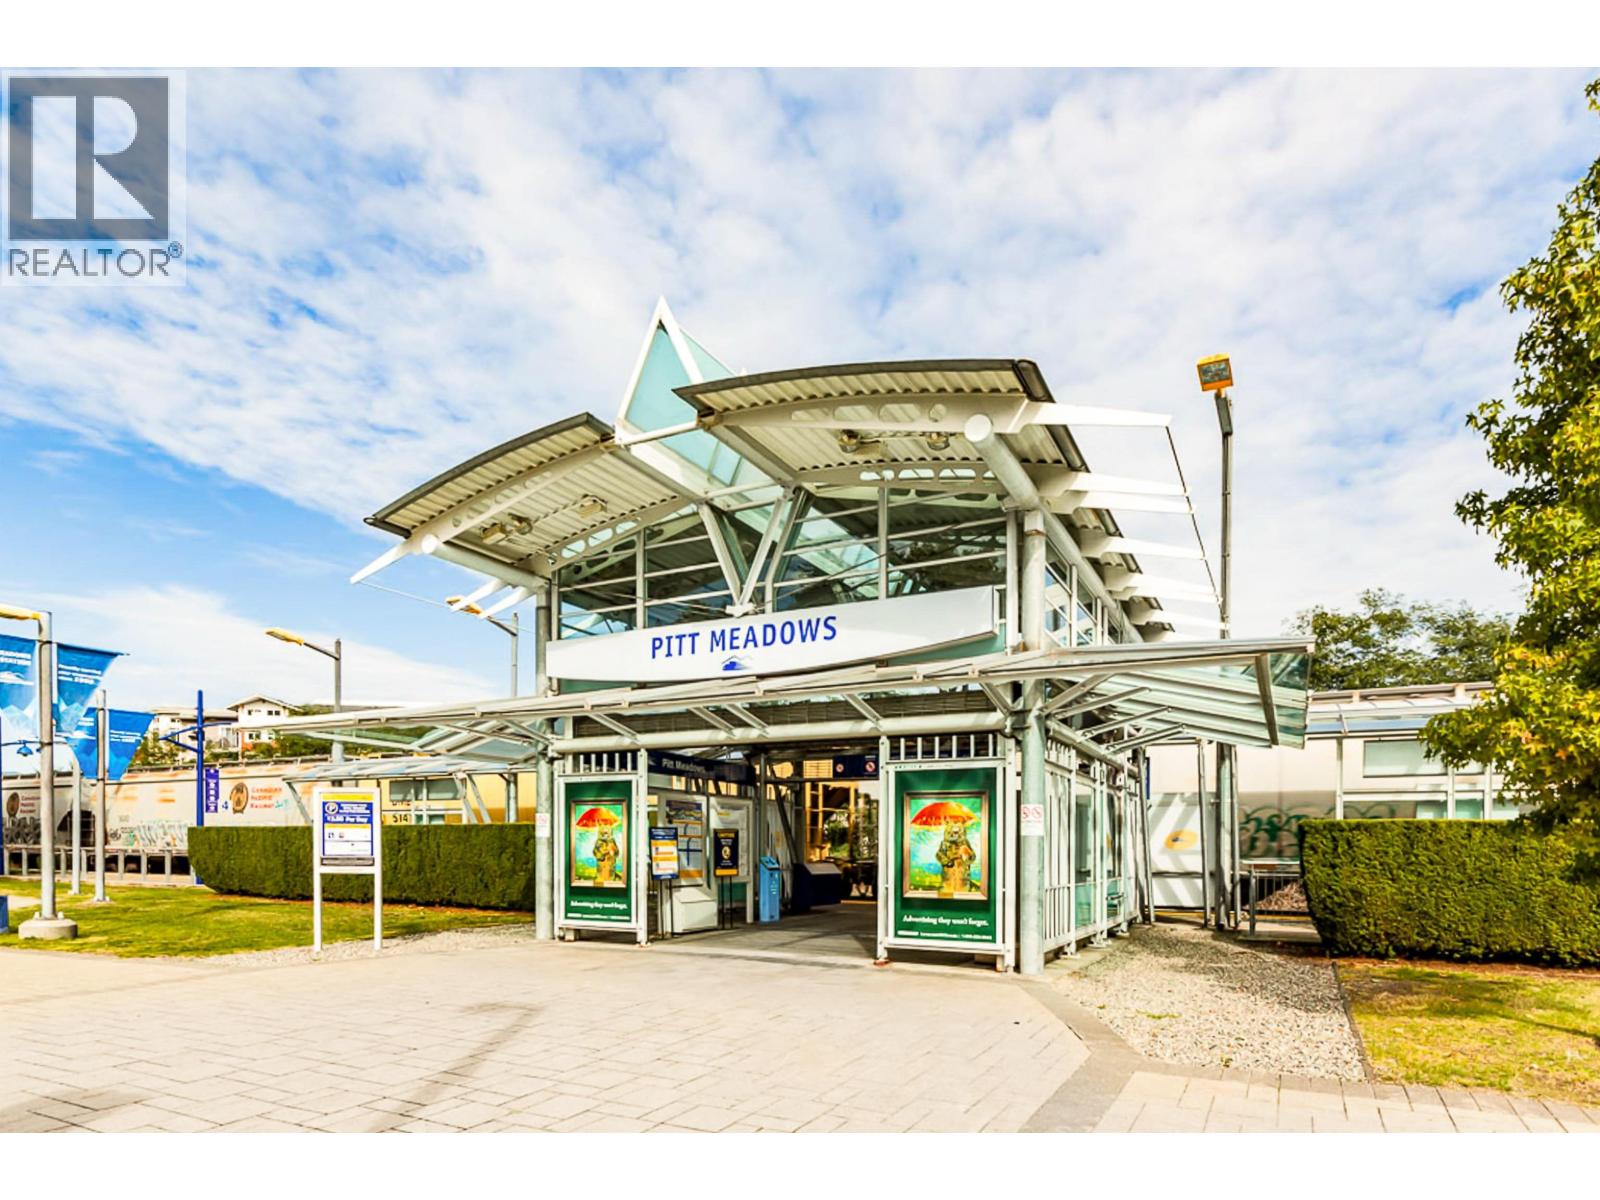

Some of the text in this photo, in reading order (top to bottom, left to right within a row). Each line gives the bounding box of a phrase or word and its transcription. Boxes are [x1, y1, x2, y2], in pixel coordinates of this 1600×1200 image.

[651, 616, 838, 660] PITT MEADOWS
[903, 915, 937, 924] Advertising
[938, 916, 951, 925] they
